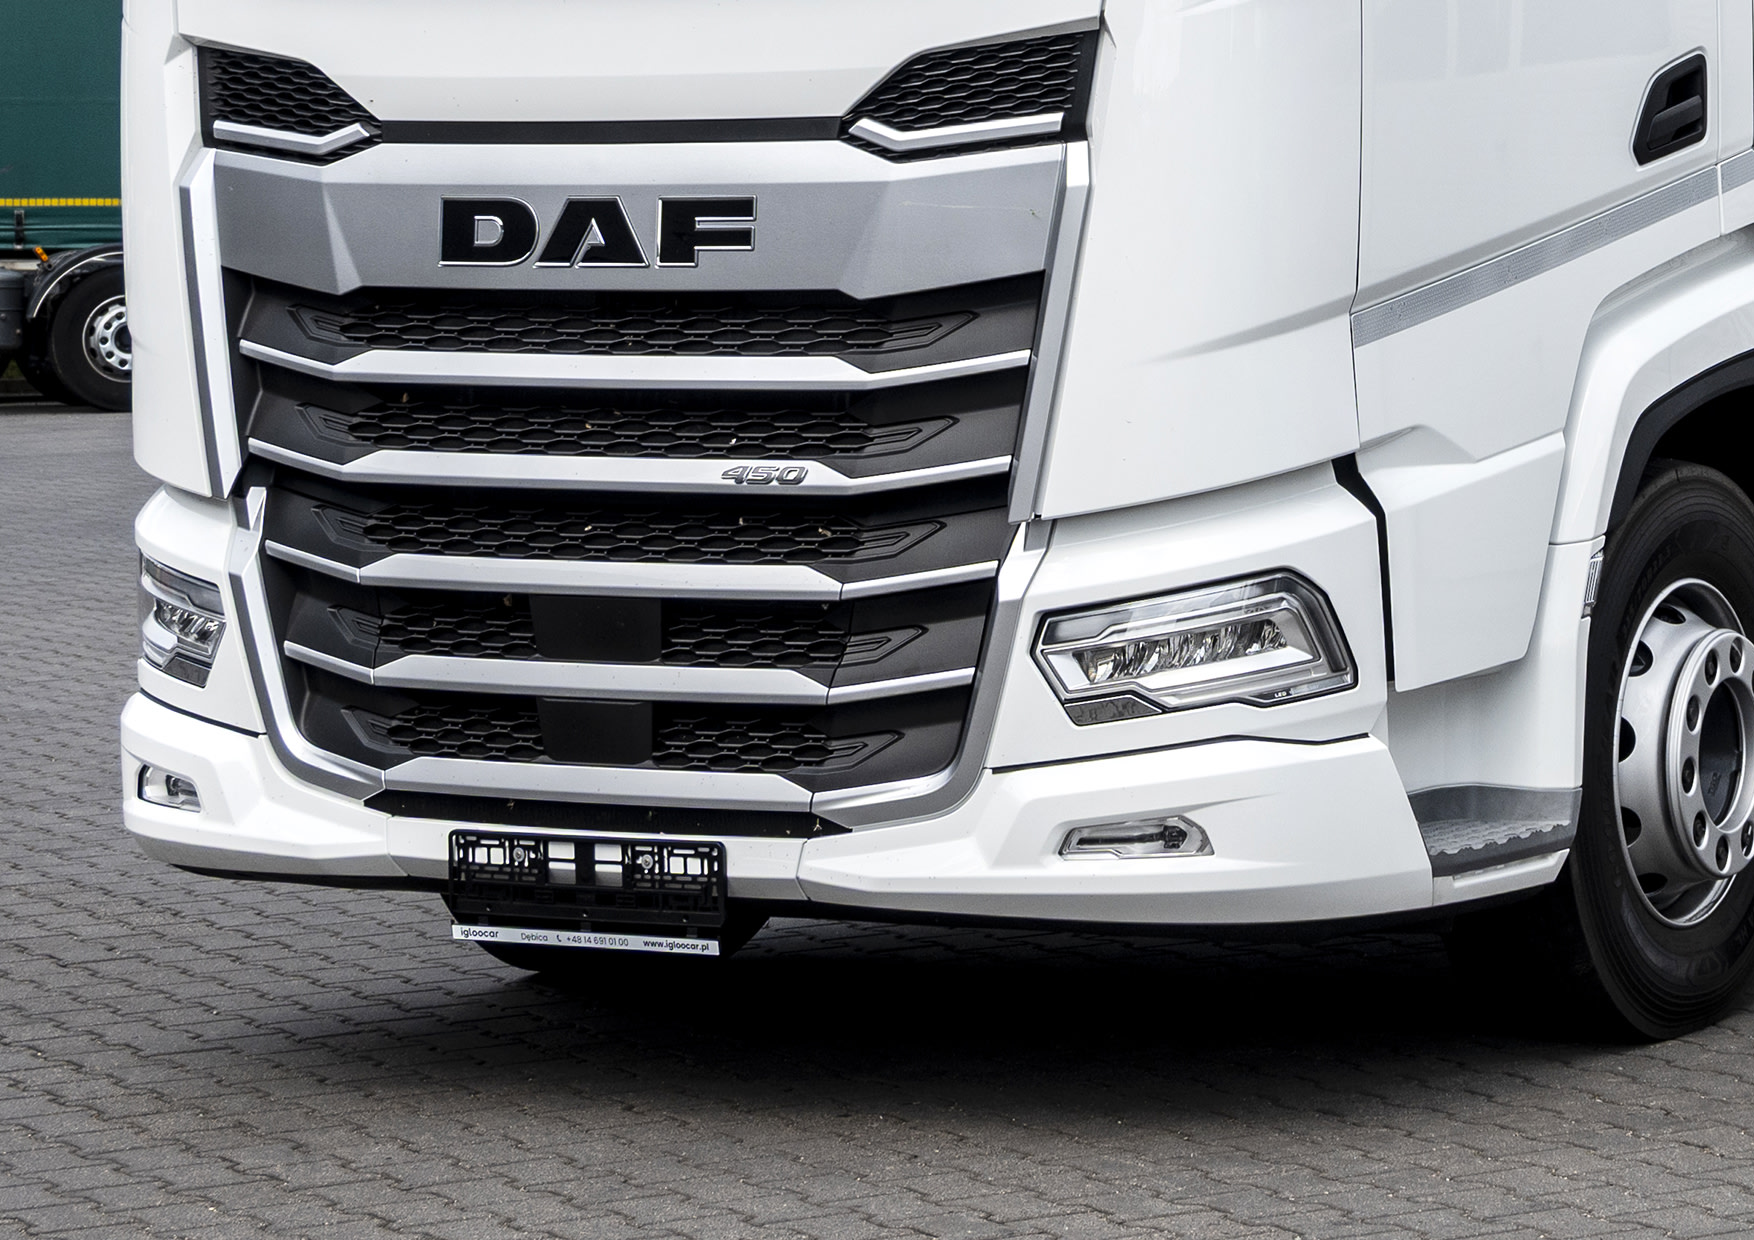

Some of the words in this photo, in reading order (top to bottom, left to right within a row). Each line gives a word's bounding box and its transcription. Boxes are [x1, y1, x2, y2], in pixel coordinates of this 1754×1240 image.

[438, 194, 757, 269] DAF
[720, 465, 809, 485] 450
[460, 927, 499, 939] igloocar
[521, 932, 549, 942] Dębica
[566, 935, 582, 944] +48
[584, 936, 592, 944] 14
[594, 936, 607, 945] 691
[608, 937, 617, 946] 01
[618, 938, 629, 947] 00
[642, 939, 710, 952] www.igloocar.pl
